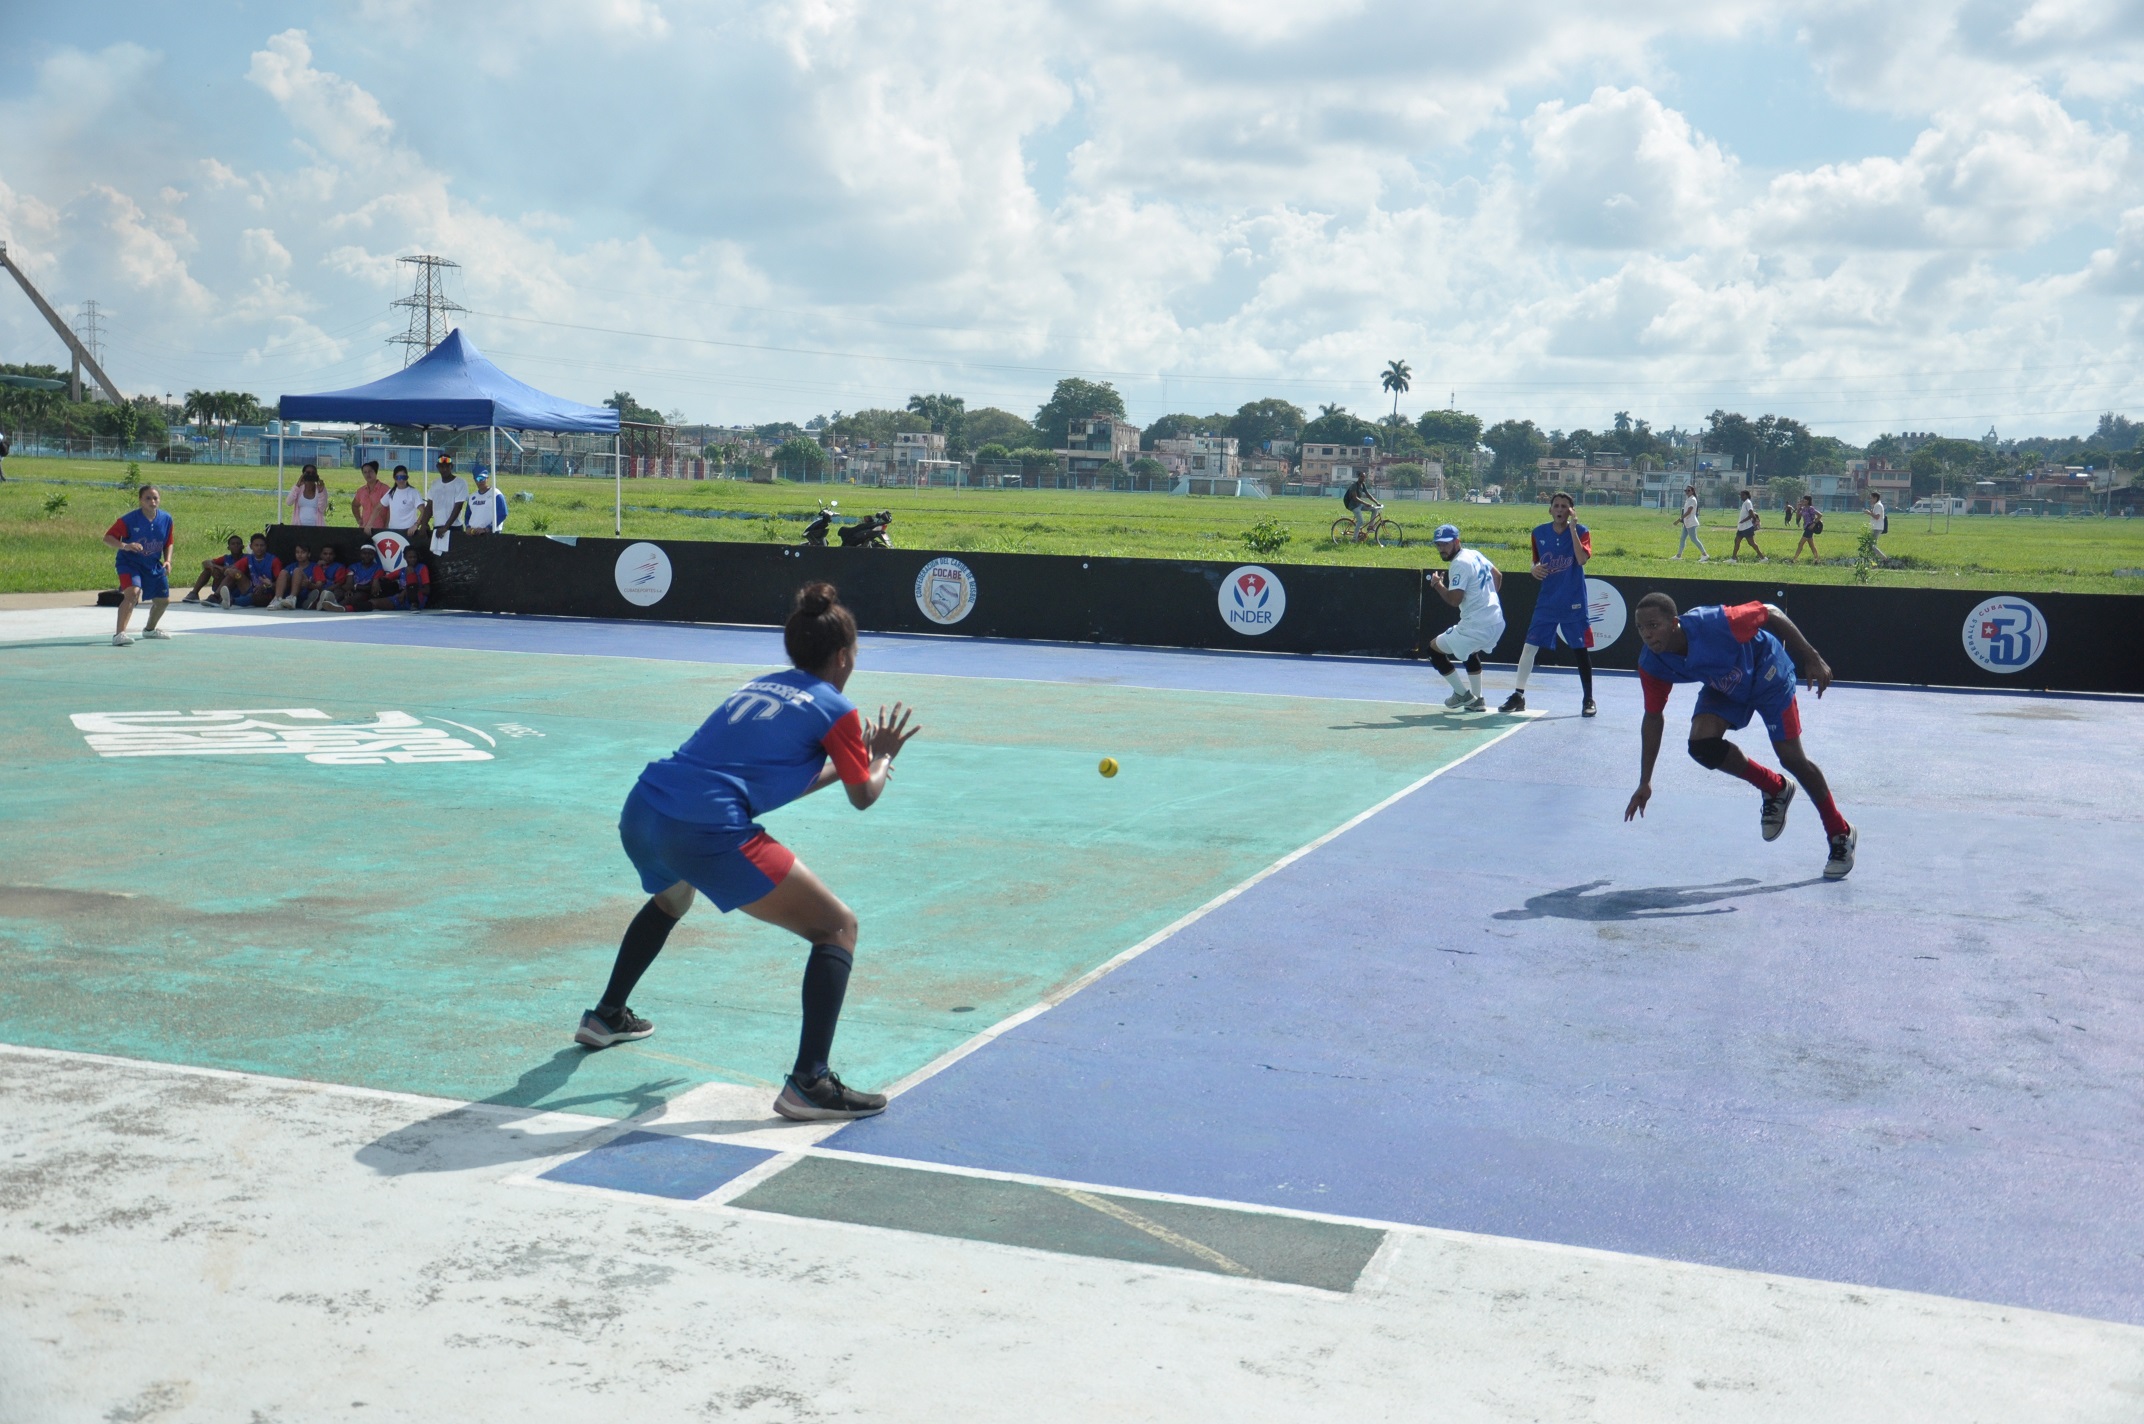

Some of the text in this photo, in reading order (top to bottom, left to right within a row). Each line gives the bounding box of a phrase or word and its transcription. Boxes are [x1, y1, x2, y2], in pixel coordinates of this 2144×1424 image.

[940, 557, 949, 565] DEL
[932, 568, 962, 580] COCABE
[1978, 604, 2003, 617] CUBA
[1230, 610, 1272, 624] INDER
